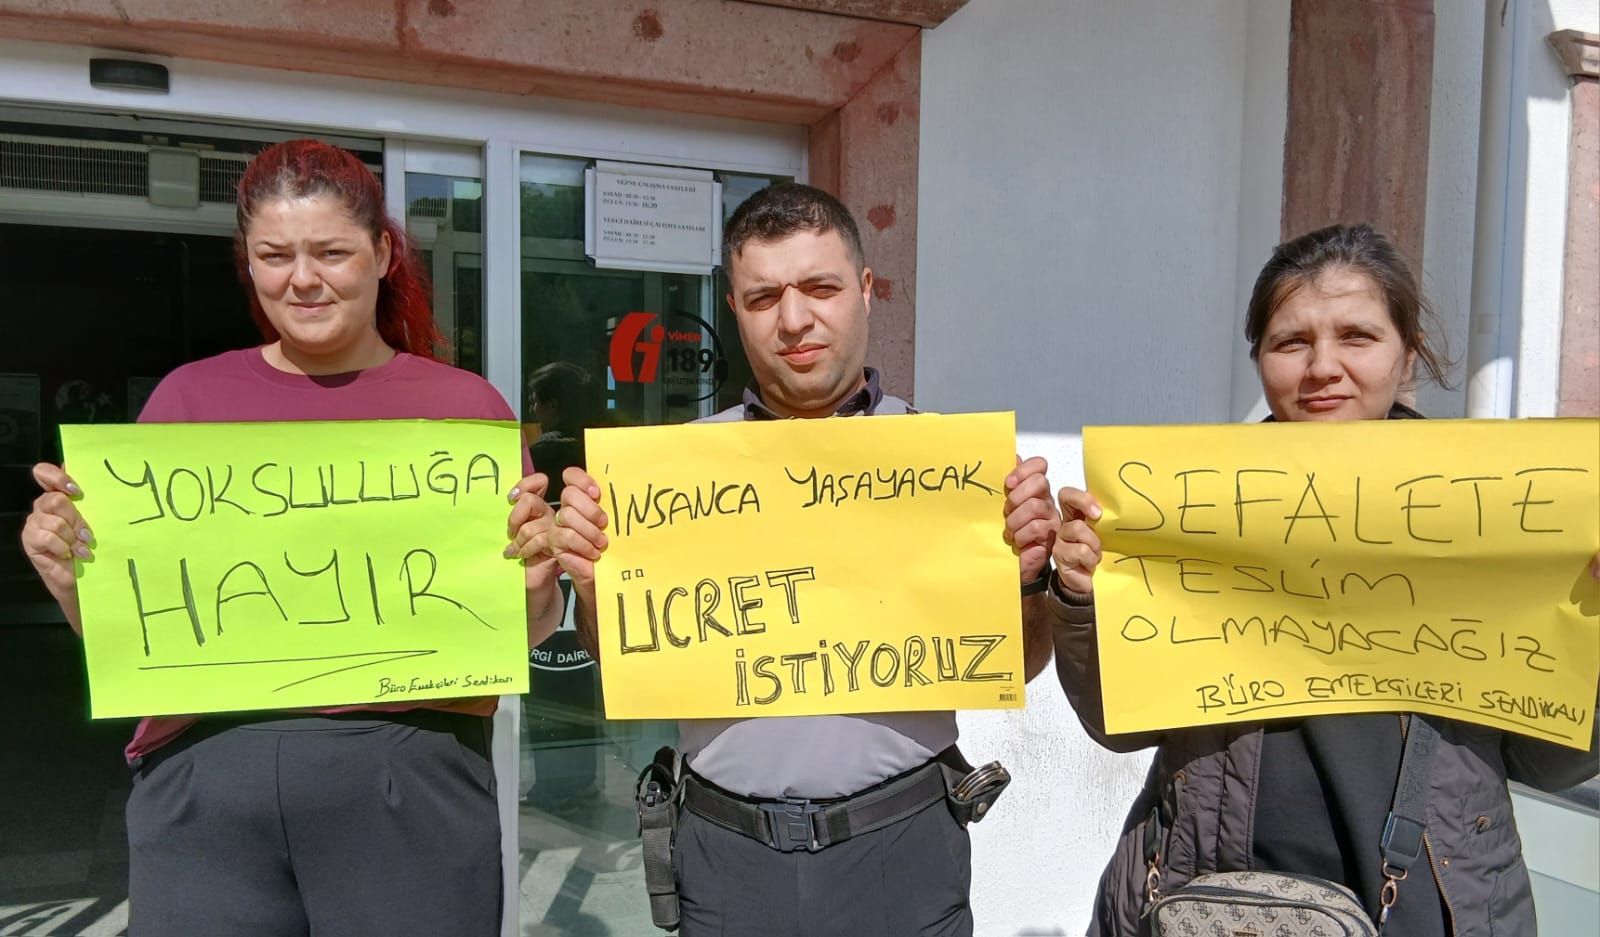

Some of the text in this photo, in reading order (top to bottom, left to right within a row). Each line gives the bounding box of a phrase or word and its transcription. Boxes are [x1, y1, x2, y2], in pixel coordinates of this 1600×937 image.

[104, 450, 500, 525] YOKSULLUĞA
[605, 460, 1003, 537] İNSANCA YAŞAYACAK
[1115, 461, 1588, 545] SEFALETE
[127, 548, 499, 657] HAYIR
[616, 566, 816, 656] ÜCRET
[1114, 555, 1415, 606] TESLİM
[735, 634, 1014, 707] İSTİYORUZ
[1120, 615, 1557, 673] OLMAYACAĞIZ
[375, 677, 406, 698] Büro
[1196, 673, 1285, 714] BÜRO
